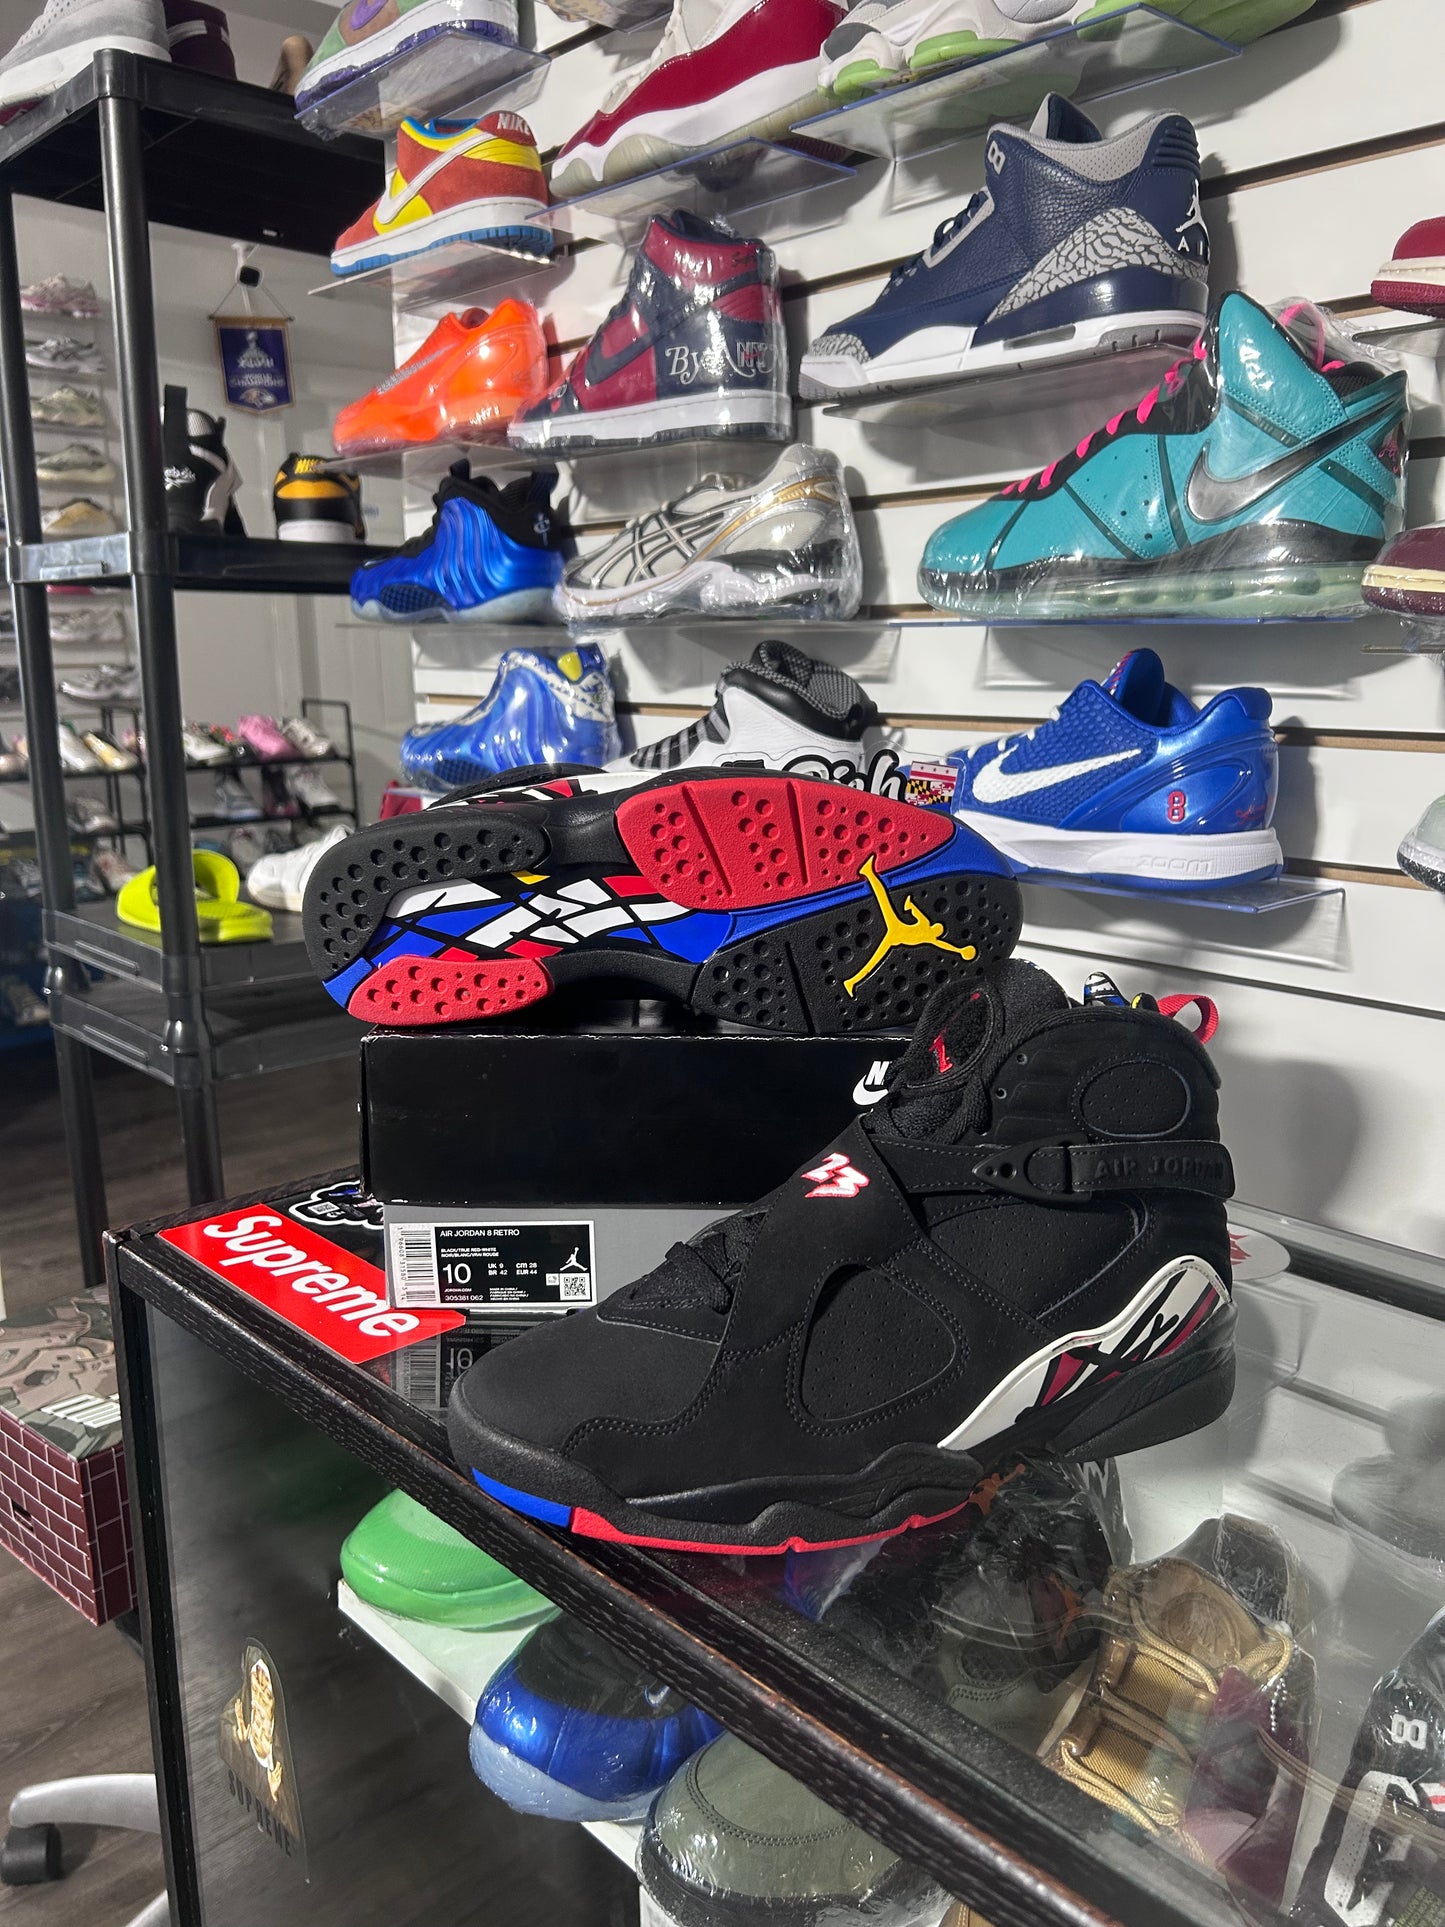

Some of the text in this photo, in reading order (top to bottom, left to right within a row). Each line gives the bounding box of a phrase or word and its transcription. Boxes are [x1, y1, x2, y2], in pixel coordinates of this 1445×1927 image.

[1167, 790, 1188, 824] 8
[1094, 1154, 1137, 1179] AIR
[454, 1229, 485, 1237] JORDAN
[493, 1228, 520, 1236] RETRO
[203, 1215, 420, 1337] Supreme
[442, 1263, 472, 1284] 10
[228, 1768, 292, 1858] SUPREME
